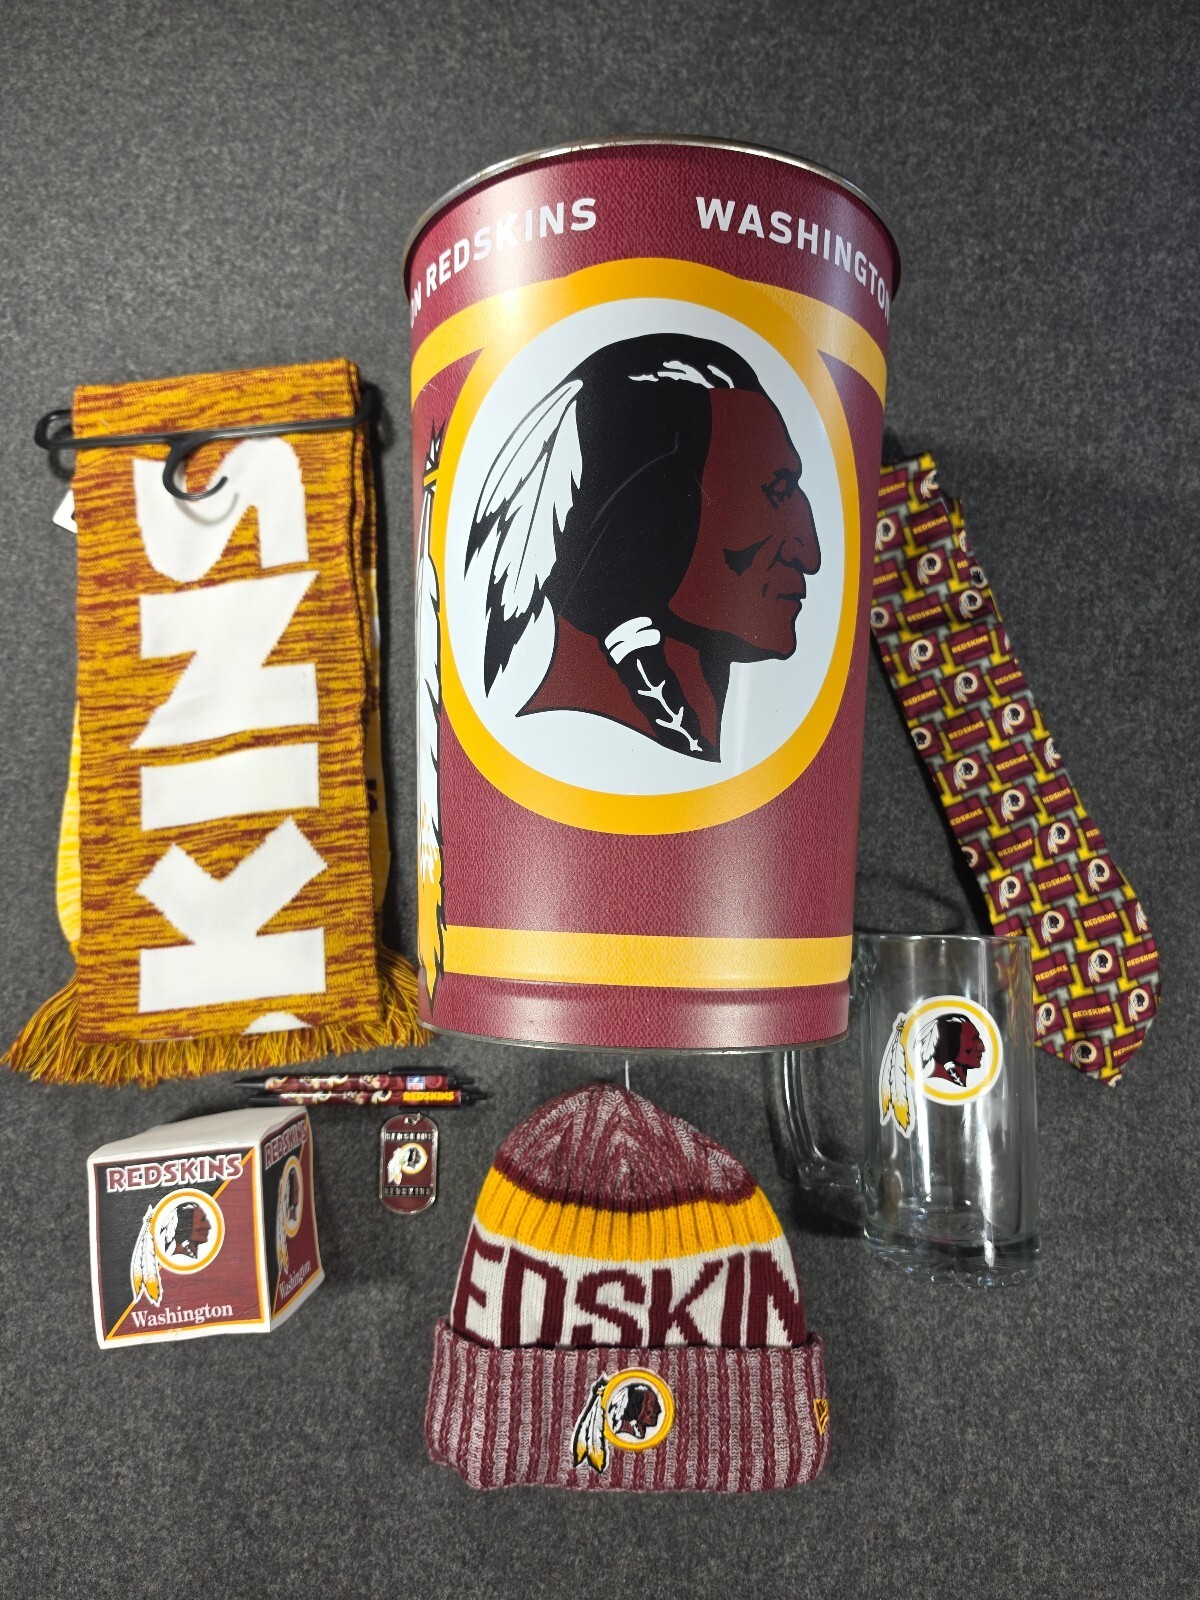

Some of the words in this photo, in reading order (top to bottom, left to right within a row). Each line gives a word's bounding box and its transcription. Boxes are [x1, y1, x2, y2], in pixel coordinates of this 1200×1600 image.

[426, 198, 598, 298] REDSKINS
[913, 516, 949, 535] REDSKINS
[907, 606, 942, 623] REDSKINS
[951, 635, 988, 653] REDSKINS
[903, 689, 937, 707] REDSKINS
[128, 436, 328, 1034] KINS
[948, 721, 985, 740] REDSKINS
[996, 754, 1028, 771] REDSKINS
[1043, 787, 1071, 804] REDSKINS
[950, 808, 982, 826] EDSKINS
[998, 838, 1033, 857] REDSKINS
[1038, 874, 1072, 891] REDSKINS
[1083, 911, 1117, 929] REDSKINS
[1072, 1005, 1111, 1019] REDSKINS
[402, 1091, 455, 1102] REDSKINS
[264, 1120, 308, 1170] REDSKINS
[106, 1153, 243, 1193] REDSKINS
[453, 1224, 807, 1348] EDSKIN
[131, 1302, 234, 1328] Washington
